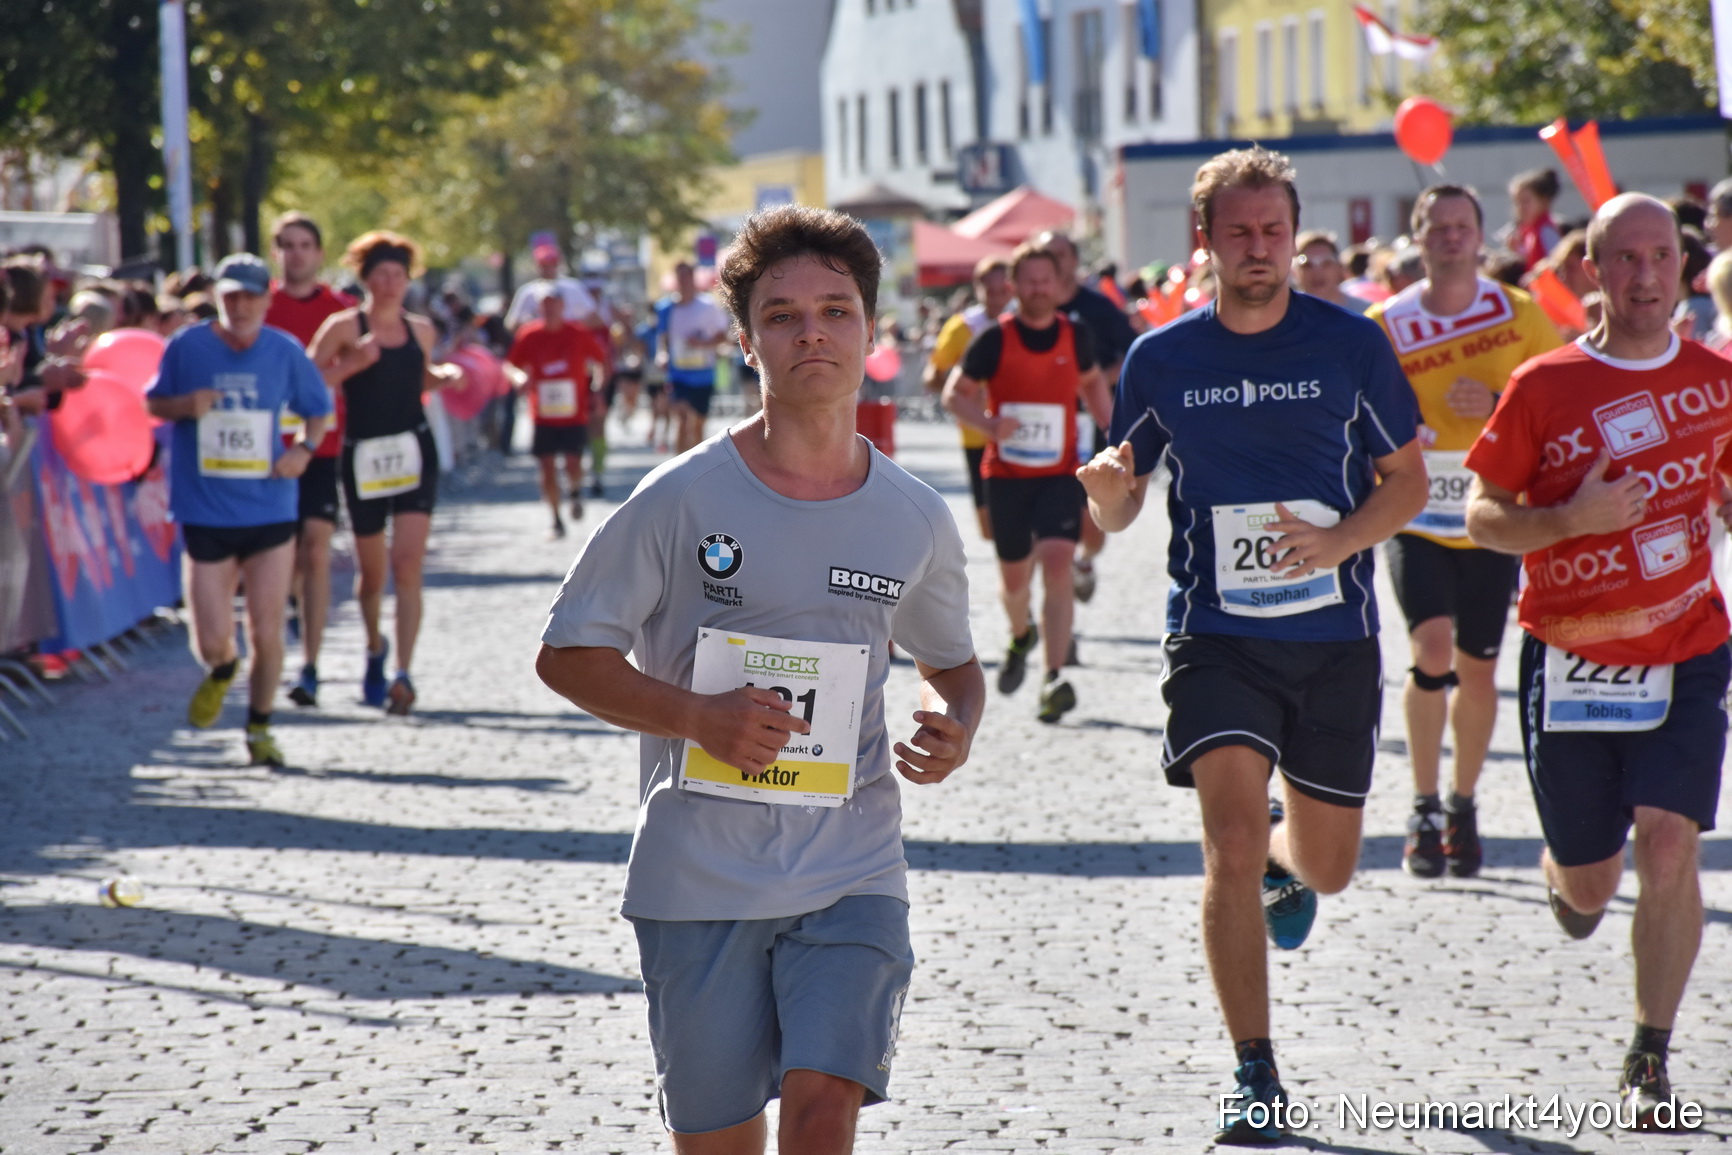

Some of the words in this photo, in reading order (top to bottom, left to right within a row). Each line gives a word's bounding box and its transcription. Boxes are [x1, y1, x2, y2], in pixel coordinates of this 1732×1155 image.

[1401, 350, 1455, 376] MAX
[1462, 328, 1523, 359] BÖGL
[1184, 386, 1240, 408] EURO
[1259, 379, 1322, 402] POLES
[1661, 378, 1732, 422] rau
[1598, 397, 1650, 422] raumbox
[217, 429, 255, 451] 165
[1540, 426, 1593, 471] ox
[1428, 474, 1474, 502] 39
[1247, 510, 1301, 528] BO
[701, 534, 740, 551] BMW
[1638, 521, 1684, 543] raumbox
[1233, 534, 1301, 571] 26
[703, 581, 743, 599] PARTL
[829, 566, 905, 600] BOCK
[1243, 576, 1269, 584] PARTL
[704, 591, 743, 607] Neumarkt
[828, 587, 854, 598] inspired
[855, 592, 864, 600] by
[864, 595, 882, 604] smart
[1250, 586, 1310, 606] Stephan
[743, 668, 767, 677] inspired
[767, 669, 776, 678] by
[744, 650, 820, 675] BOCK
[1584, 703, 1633, 720] Tobias
[778, 744, 809, 755] markt
